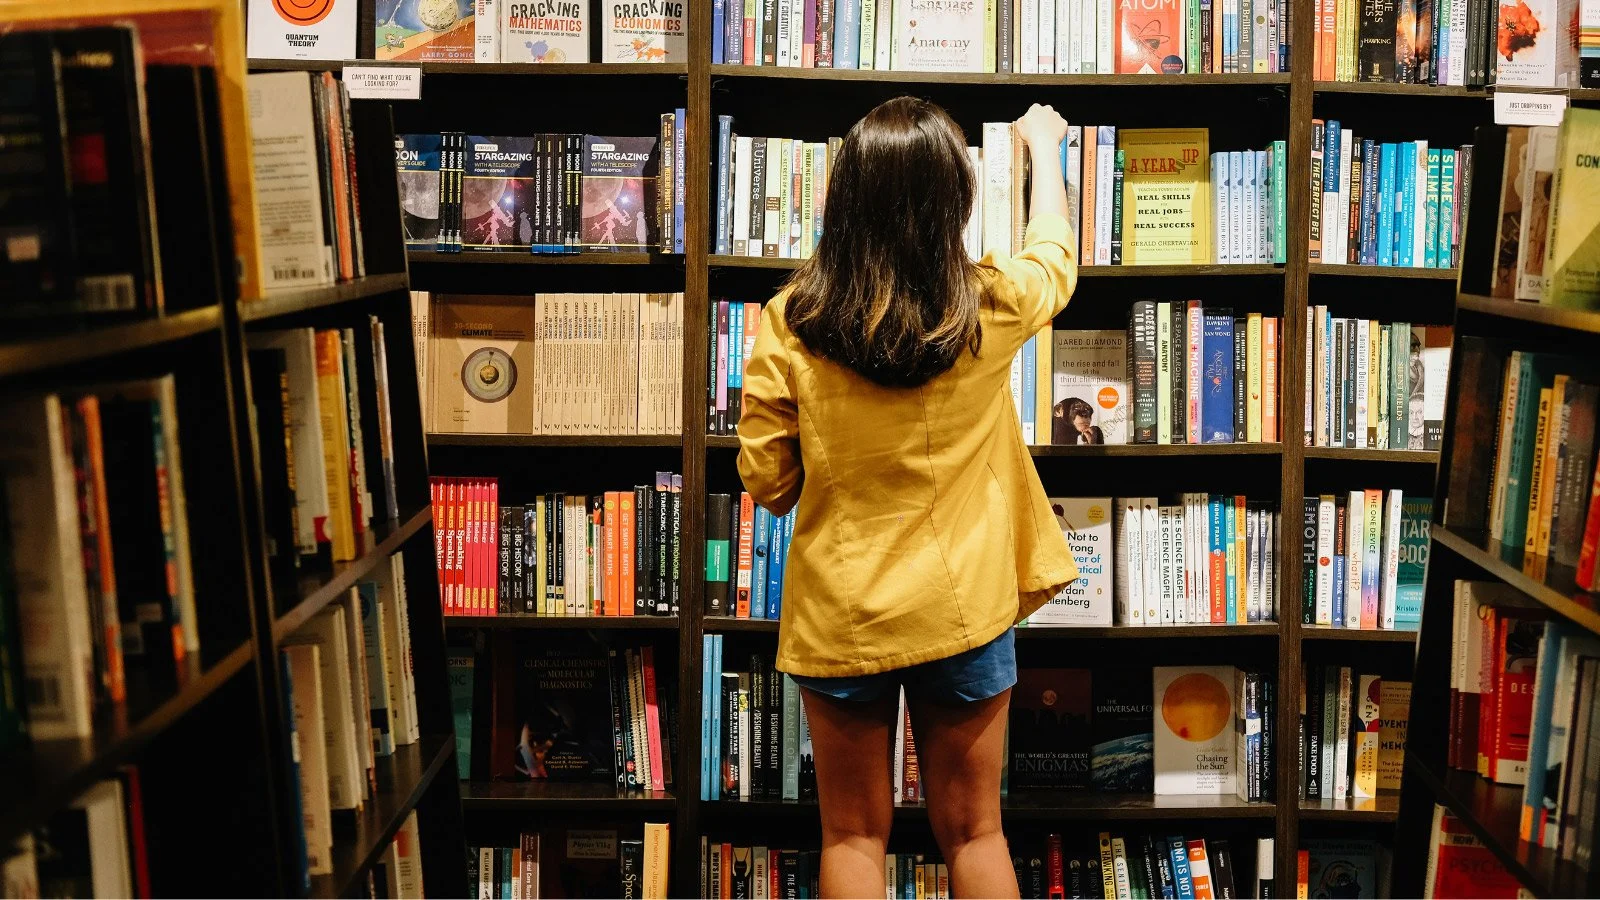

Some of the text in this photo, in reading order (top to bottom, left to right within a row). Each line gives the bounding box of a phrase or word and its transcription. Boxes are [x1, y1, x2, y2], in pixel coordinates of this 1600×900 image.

[511, 1, 580, 19] CRACKING
[614, 0, 683, 19] CRACKING
[509, 17, 582, 32] MATHEMATICS
[614, 18, 681, 31] ECONOMICS
[780, 6, 789, 40] CREATIVITY
[1242, 9, 1250, 43] Brilliant
[1323, 16, 1334, 34] OUT
[285, 33, 319, 41] QUANTUM
[1364, 37, 1392, 45] HAWKING
[351, 73, 365, 81] CAN'T
[395, 74, 412, 82] YOU'RE
[386, 80, 399, 88] FOR?
[1521, 102, 1543, 110] DROPPING
[474, 152, 532, 162] STARGAZING
[591, 152, 650, 162] STARGAZING
[1182, 148, 1199, 163] UP
[752, 149, 764, 200] Universe
[1130, 158, 1177, 173] A YEAR
[1351, 162, 1361, 182] DISASTER
[1427, 154, 1439, 203] SLIME
[1441, 154, 1454, 203] SLIME
[461, 329, 493, 337] CLIMATE
[1135, 313, 1144, 342] TO WAR
[1145, 304, 1155, 351] ACCESSORY
[1190, 307, 1199, 400] HUMAN MACHINE
[1079, 376, 1122, 384] chimpanzee
[1358, 372, 1367, 400] Delicious
[1531, 448, 1543, 512] EXPERIMENTS
[1161, 509, 1169, 525] THE
[1321, 506, 1329, 548] First Fruit
[740, 521, 752, 566] SPUTNIK
[1067, 532, 1098, 541] Not to
[1175, 527, 1183, 563] SCIENCE
[1304, 512, 1315, 563] MOTH
[446, 529, 454, 570] Speaking
[456, 529, 464, 570] Speaking
[1091, 554, 1100, 563] of
[1351, 552, 1360, 591] what if?
[1389, 550, 1397, 578] AMAZING
[733, 711, 738, 720] OF
[1096, 705, 1140, 713] UNIVERSAL
[753, 745, 761, 768] REALITY
[770, 746, 778, 769] REALITY
[787, 747, 795, 759] OF
[1196, 755, 1229, 765] Chasing
[787, 765, 795, 783] LIFE
[906, 755, 917, 781] ON MARS
[1015, 760, 1089, 772] ENIGMAS
[1115, 843, 1123, 859] THE
[625, 858, 633, 871] The
[1101, 850, 1113, 886] HAWKING
[1173, 841, 1190, 896] DNA IS NOT
[787, 874, 796, 886] THE
